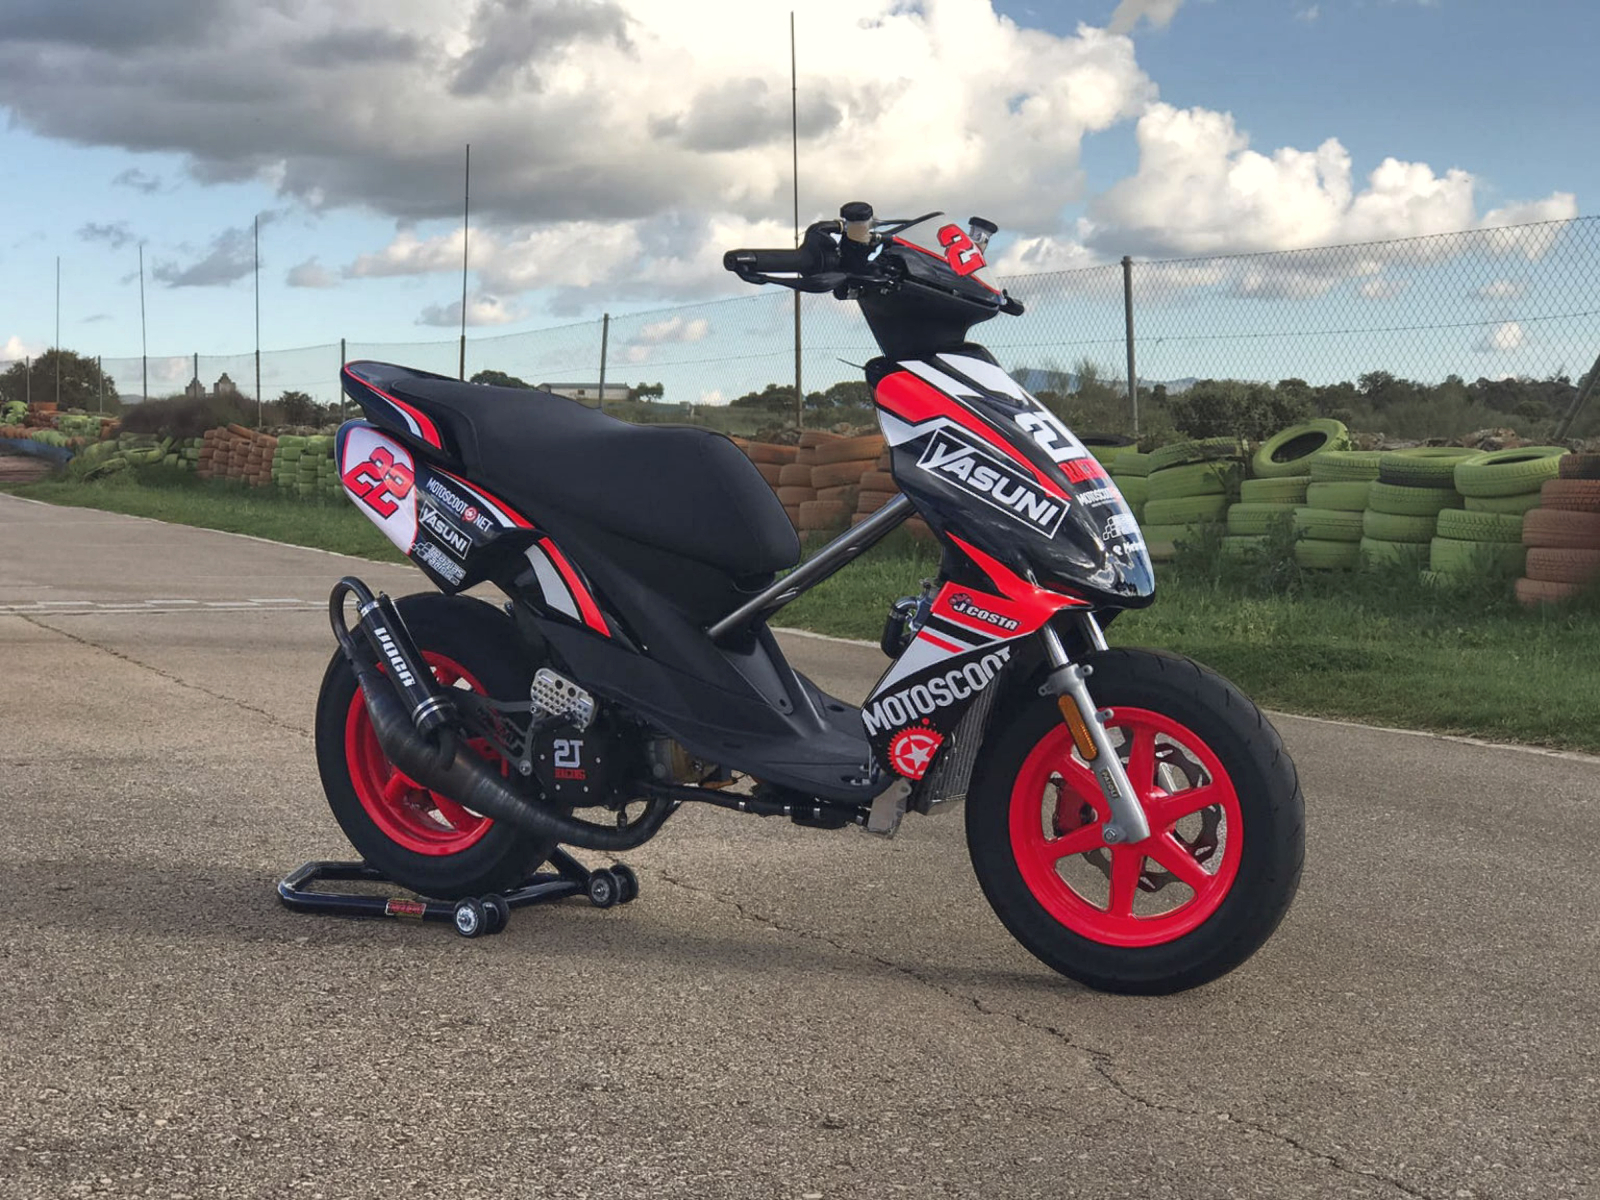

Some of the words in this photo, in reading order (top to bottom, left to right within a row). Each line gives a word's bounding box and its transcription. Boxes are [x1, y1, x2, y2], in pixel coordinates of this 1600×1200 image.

[342, 446, 415, 519] 22
[426, 477, 469, 515] MOTOSCOOT
[473, 513, 494, 532] NET
[918, 441, 1060, 527] YASUNI
[420, 508, 468, 552] YASUNI
[953, 602, 1018, 630] J.COSTA
[861, 646, 1010, 736] MOTOSCOOT
